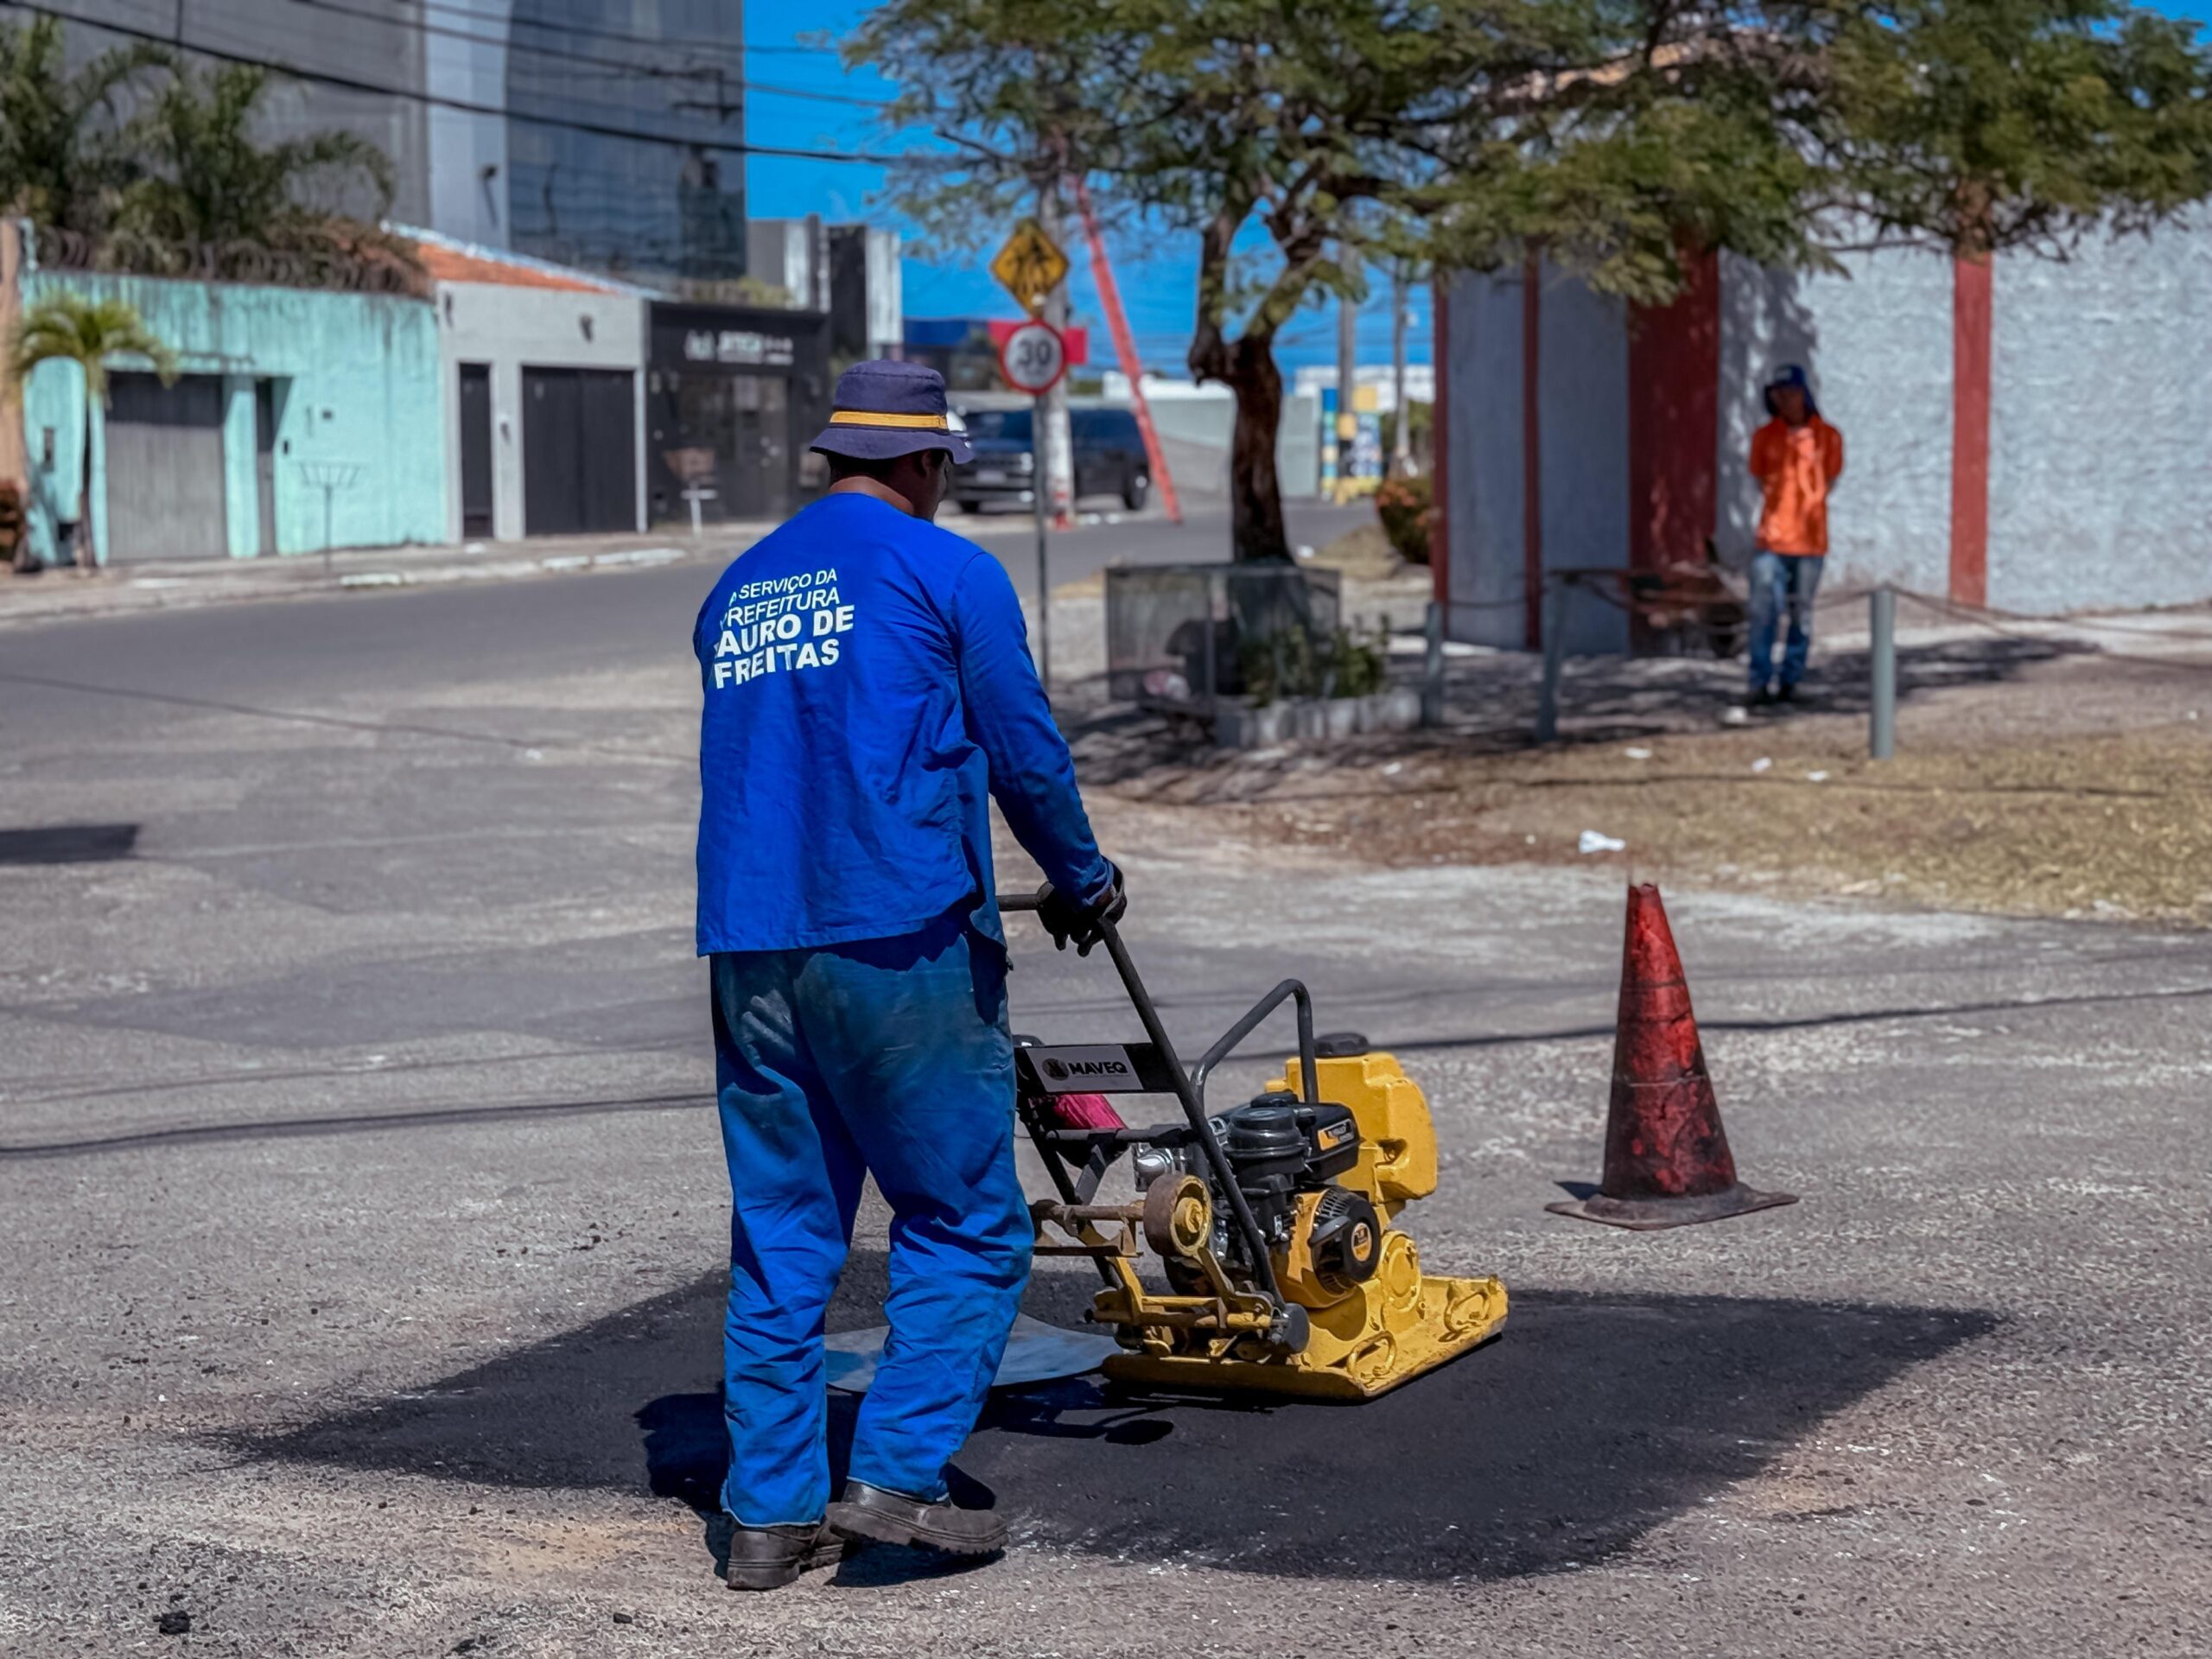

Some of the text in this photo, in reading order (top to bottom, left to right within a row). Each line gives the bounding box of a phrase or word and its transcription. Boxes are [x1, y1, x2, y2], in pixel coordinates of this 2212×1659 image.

[1018, 339, 1052, 365] 30
[739, 573, 811, 600] SERVIÇO
[815, 568, 837, 586] DA
[713, 605, 855, 658] AURO DE
[714, 639, 840, 690] FREITAS
[1068, 1061, 1128, 1075] MAVEQ
